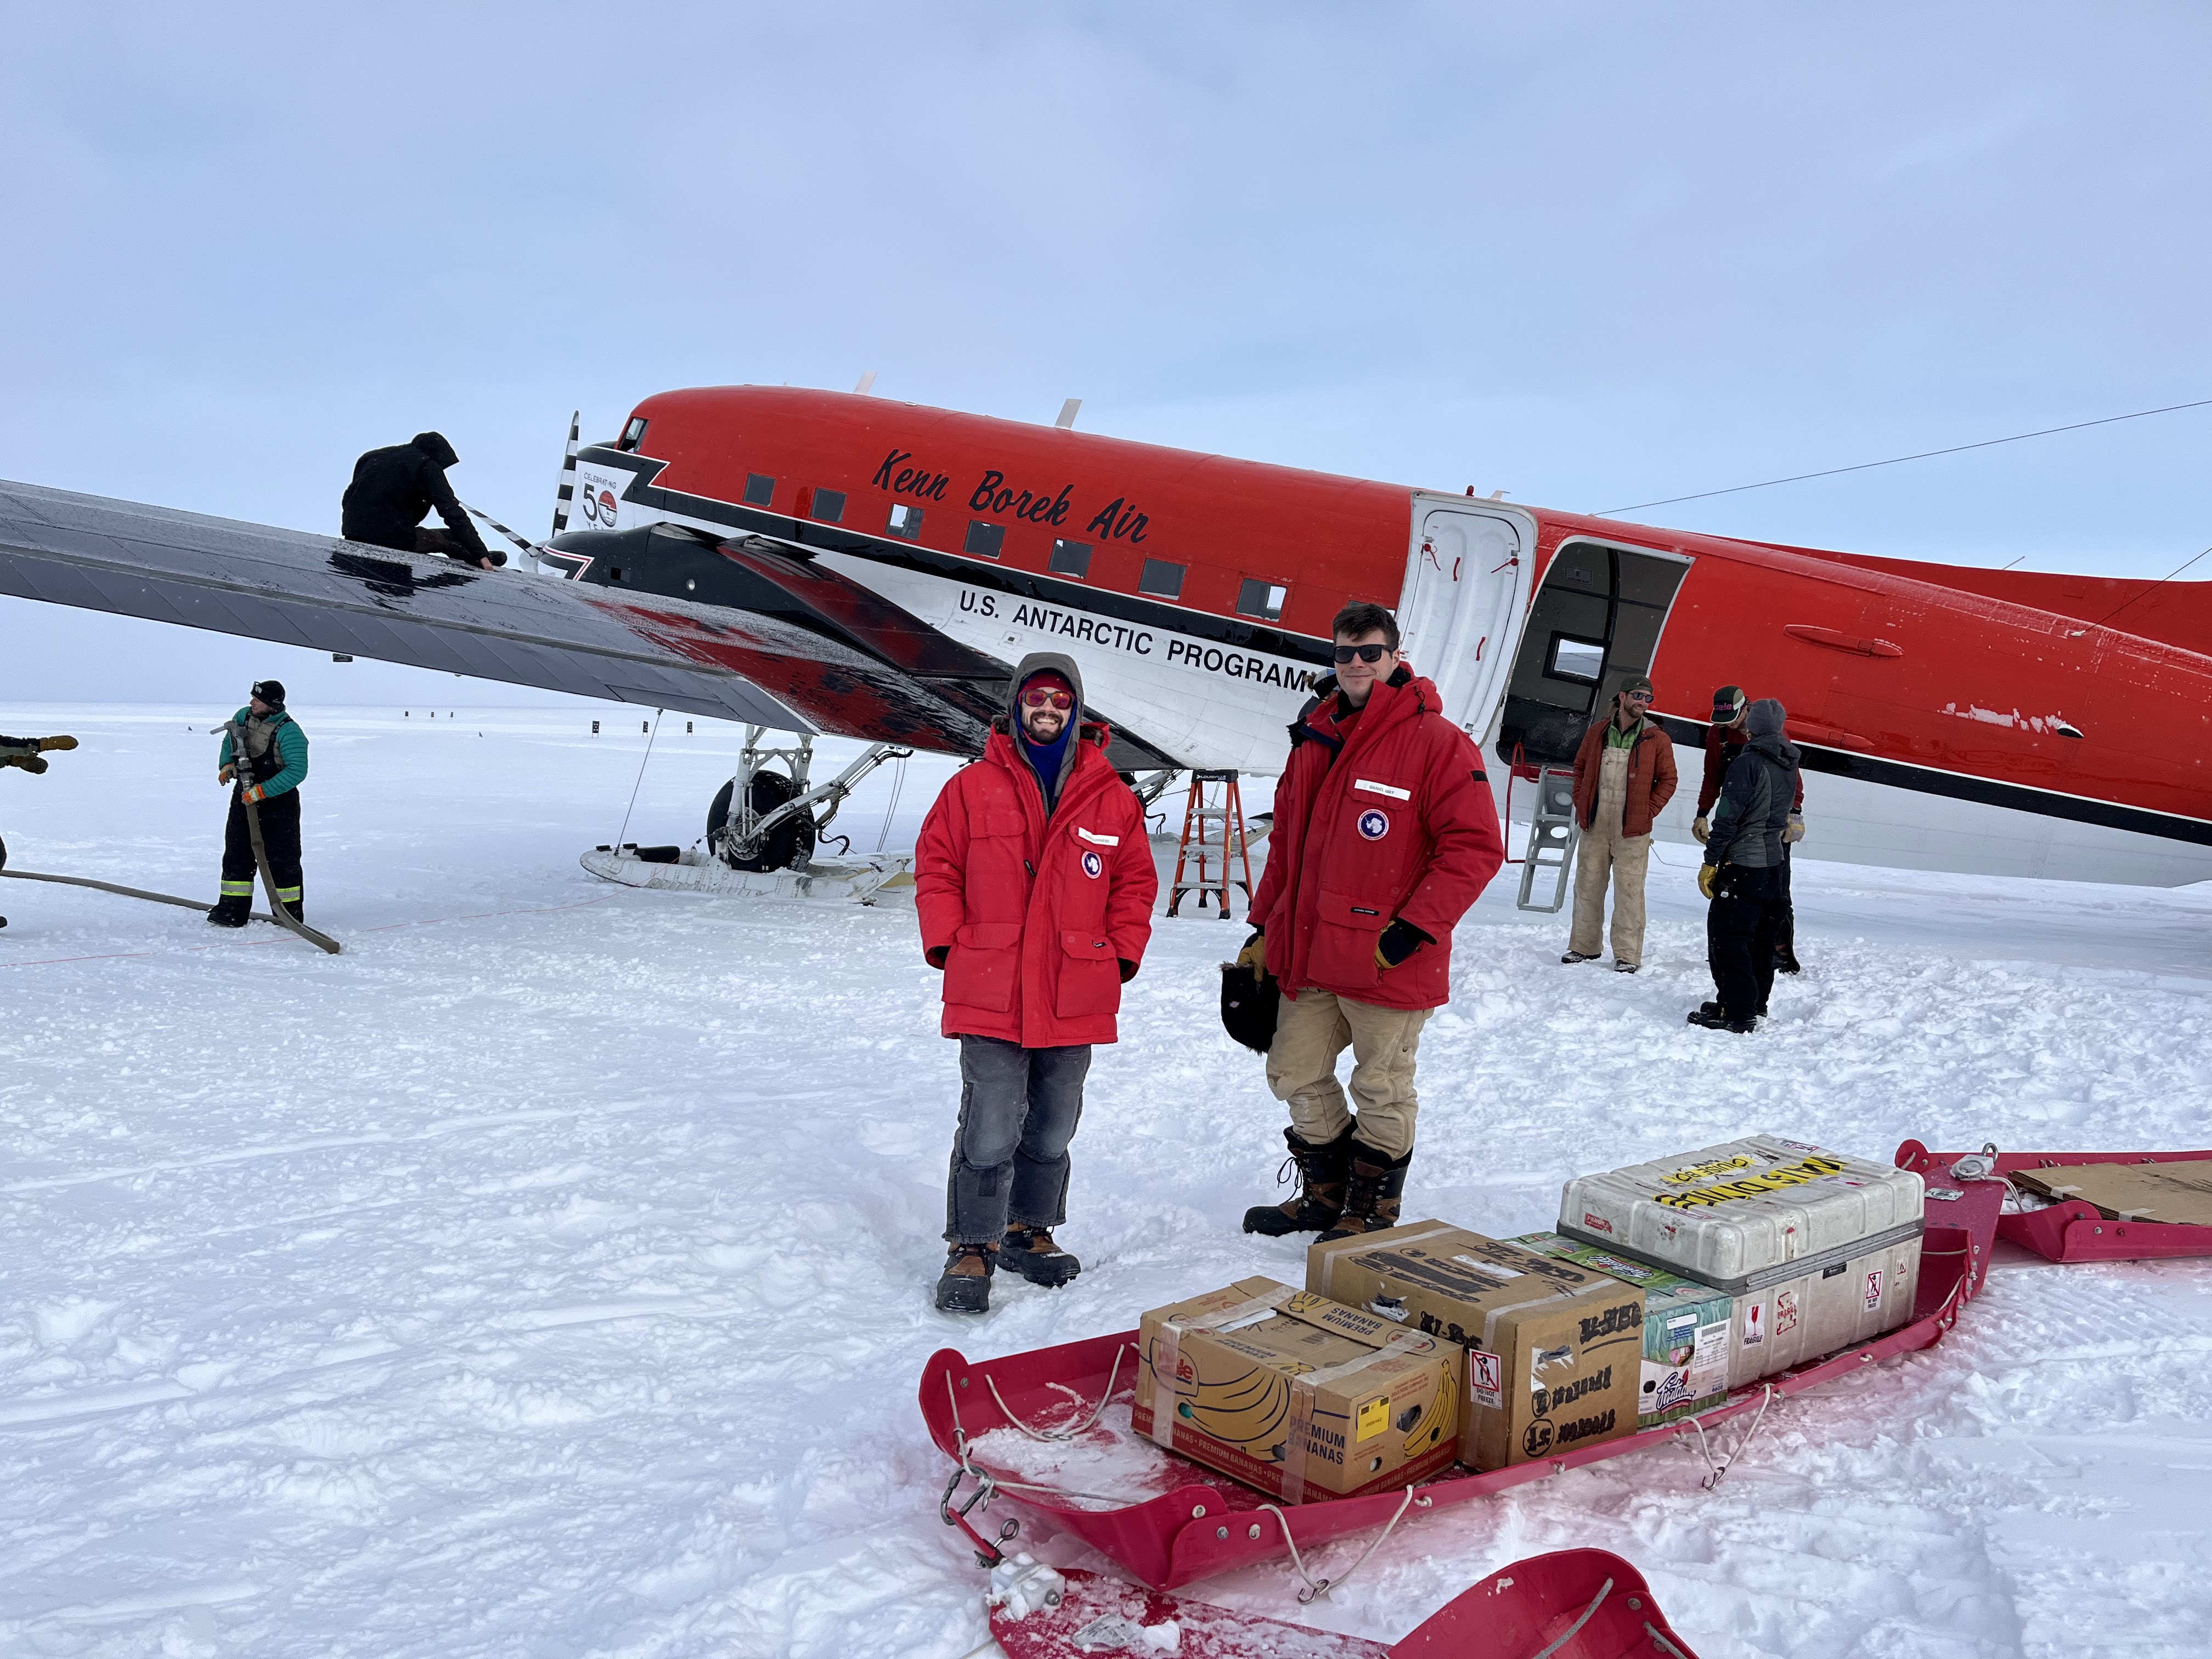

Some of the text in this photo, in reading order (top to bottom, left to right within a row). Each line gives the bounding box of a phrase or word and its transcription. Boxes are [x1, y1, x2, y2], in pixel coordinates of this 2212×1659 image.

[872, 449, 1150, 543] Kenn Borek Air
[960, 590, 1307, 693] U.S. ANTARCTIC PROGRAM
[1697, 1158, 1749, 1175] CUISE
[1322, 1313, 1375, 1336] PREMIUM
[1331, 1307, 1384, 1329] BANANAS
[1743, 1335, 1763, 1346] FRAGILE
[1477, 1393, 1494, 1404] FREEZE
[1485, 1389, 1495, 1397] NOT
[1290, 1415, 1345, 1449] PREMIUM
[1198, 1438, 1229, 1462] PREMIUM
[1229, 1452, 1263, 1475] BANANAS
[1289, 1432, 1344, 1465] BANANAS
[1380, 1470, 1404, 1485] BANANAS
[1406, 1458, 1428, 1476] PREMIUM
[1428, 1445, 1451, 1466] BANANAS
